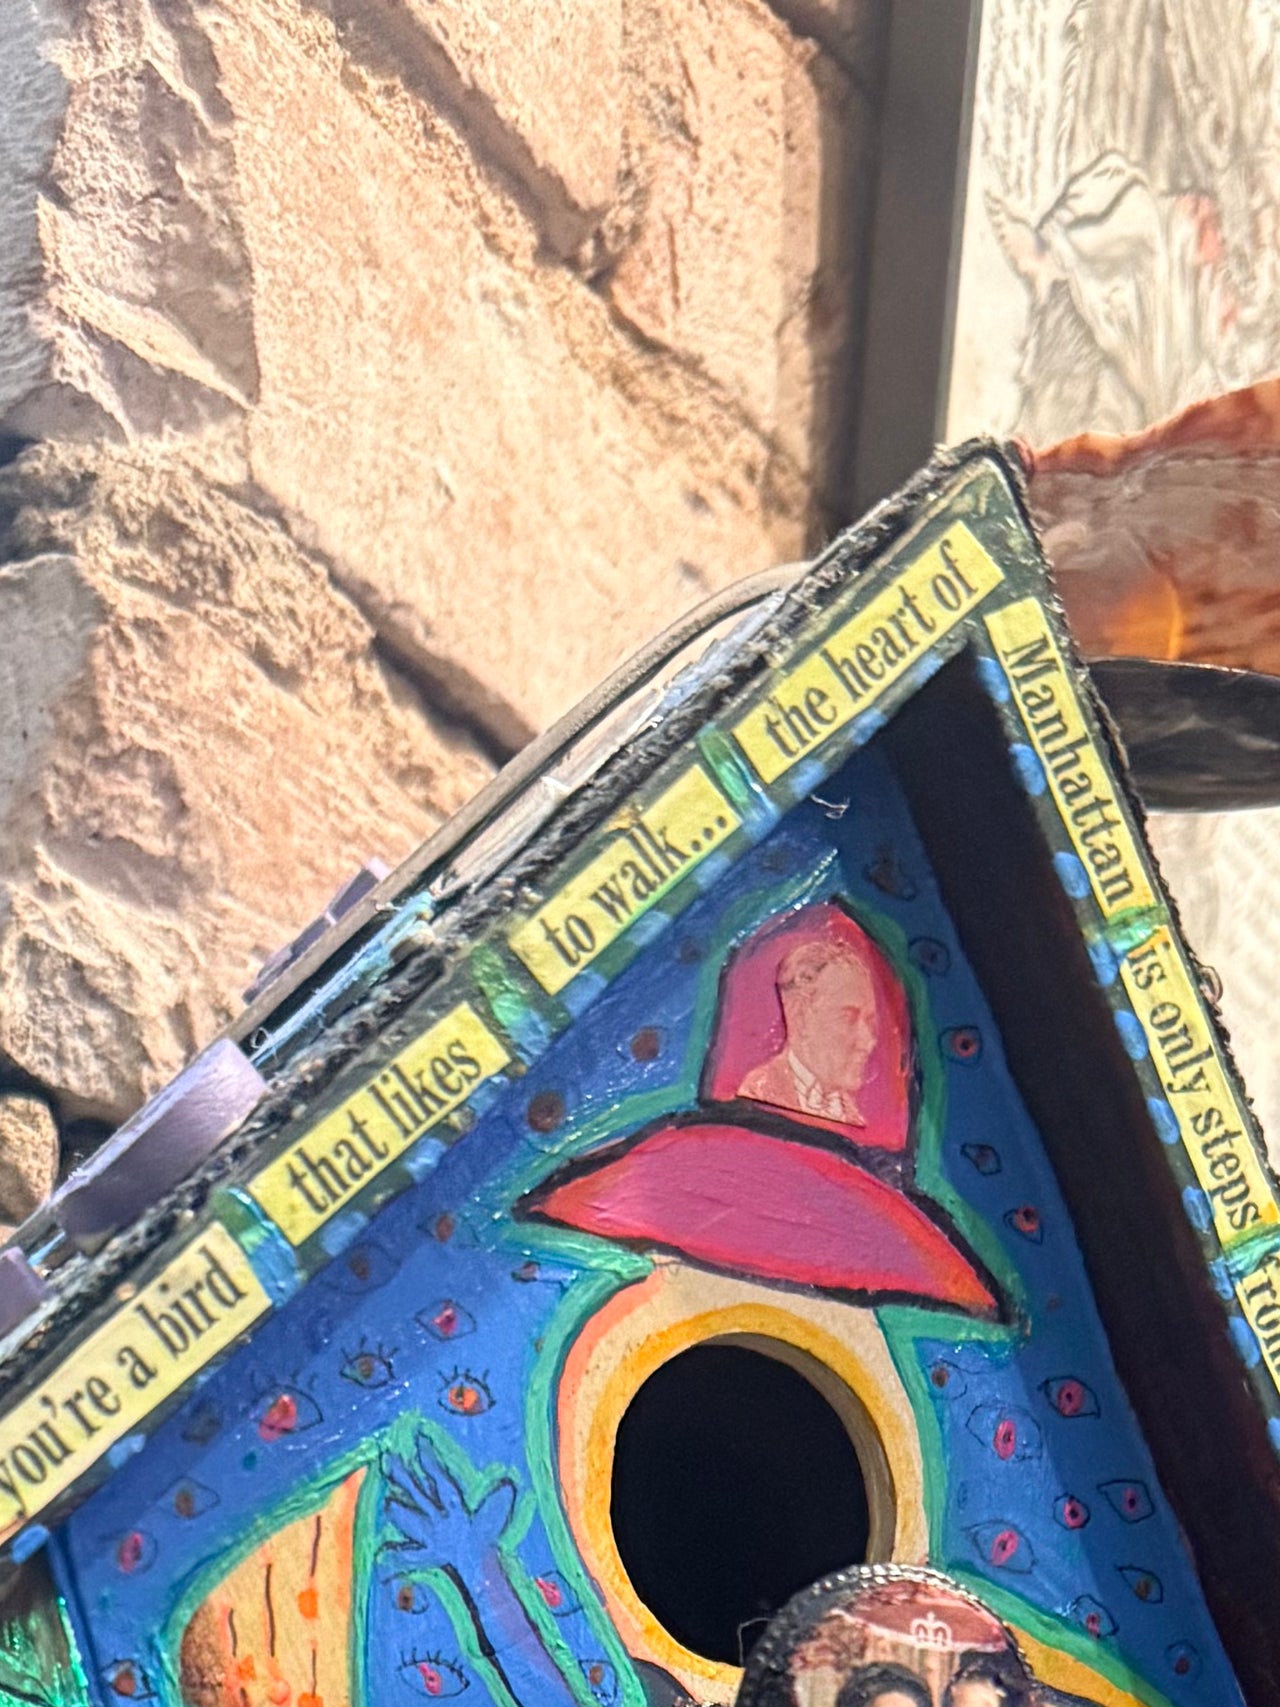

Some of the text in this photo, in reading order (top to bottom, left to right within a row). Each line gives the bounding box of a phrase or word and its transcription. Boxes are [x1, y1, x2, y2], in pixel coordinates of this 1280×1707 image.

[932, 539, 979, 612] of
[824, 585, 937, 703] heart
[762, 686, 838, 761] the
[541, 911, 597, 970] to
[1002, 633, 1138, 908] Manhattan
[1128, 940, 1170, 991] is
[1149, 1001, 1215, 1095] only
[1190, 1106, 1261, 1230] steps
[368, 1037, 481, 1142] likes
[288, 1111, 390, 1216] that
[135, 1245, 247, 1359] bird
[119, 1345, 157, 1390] a
